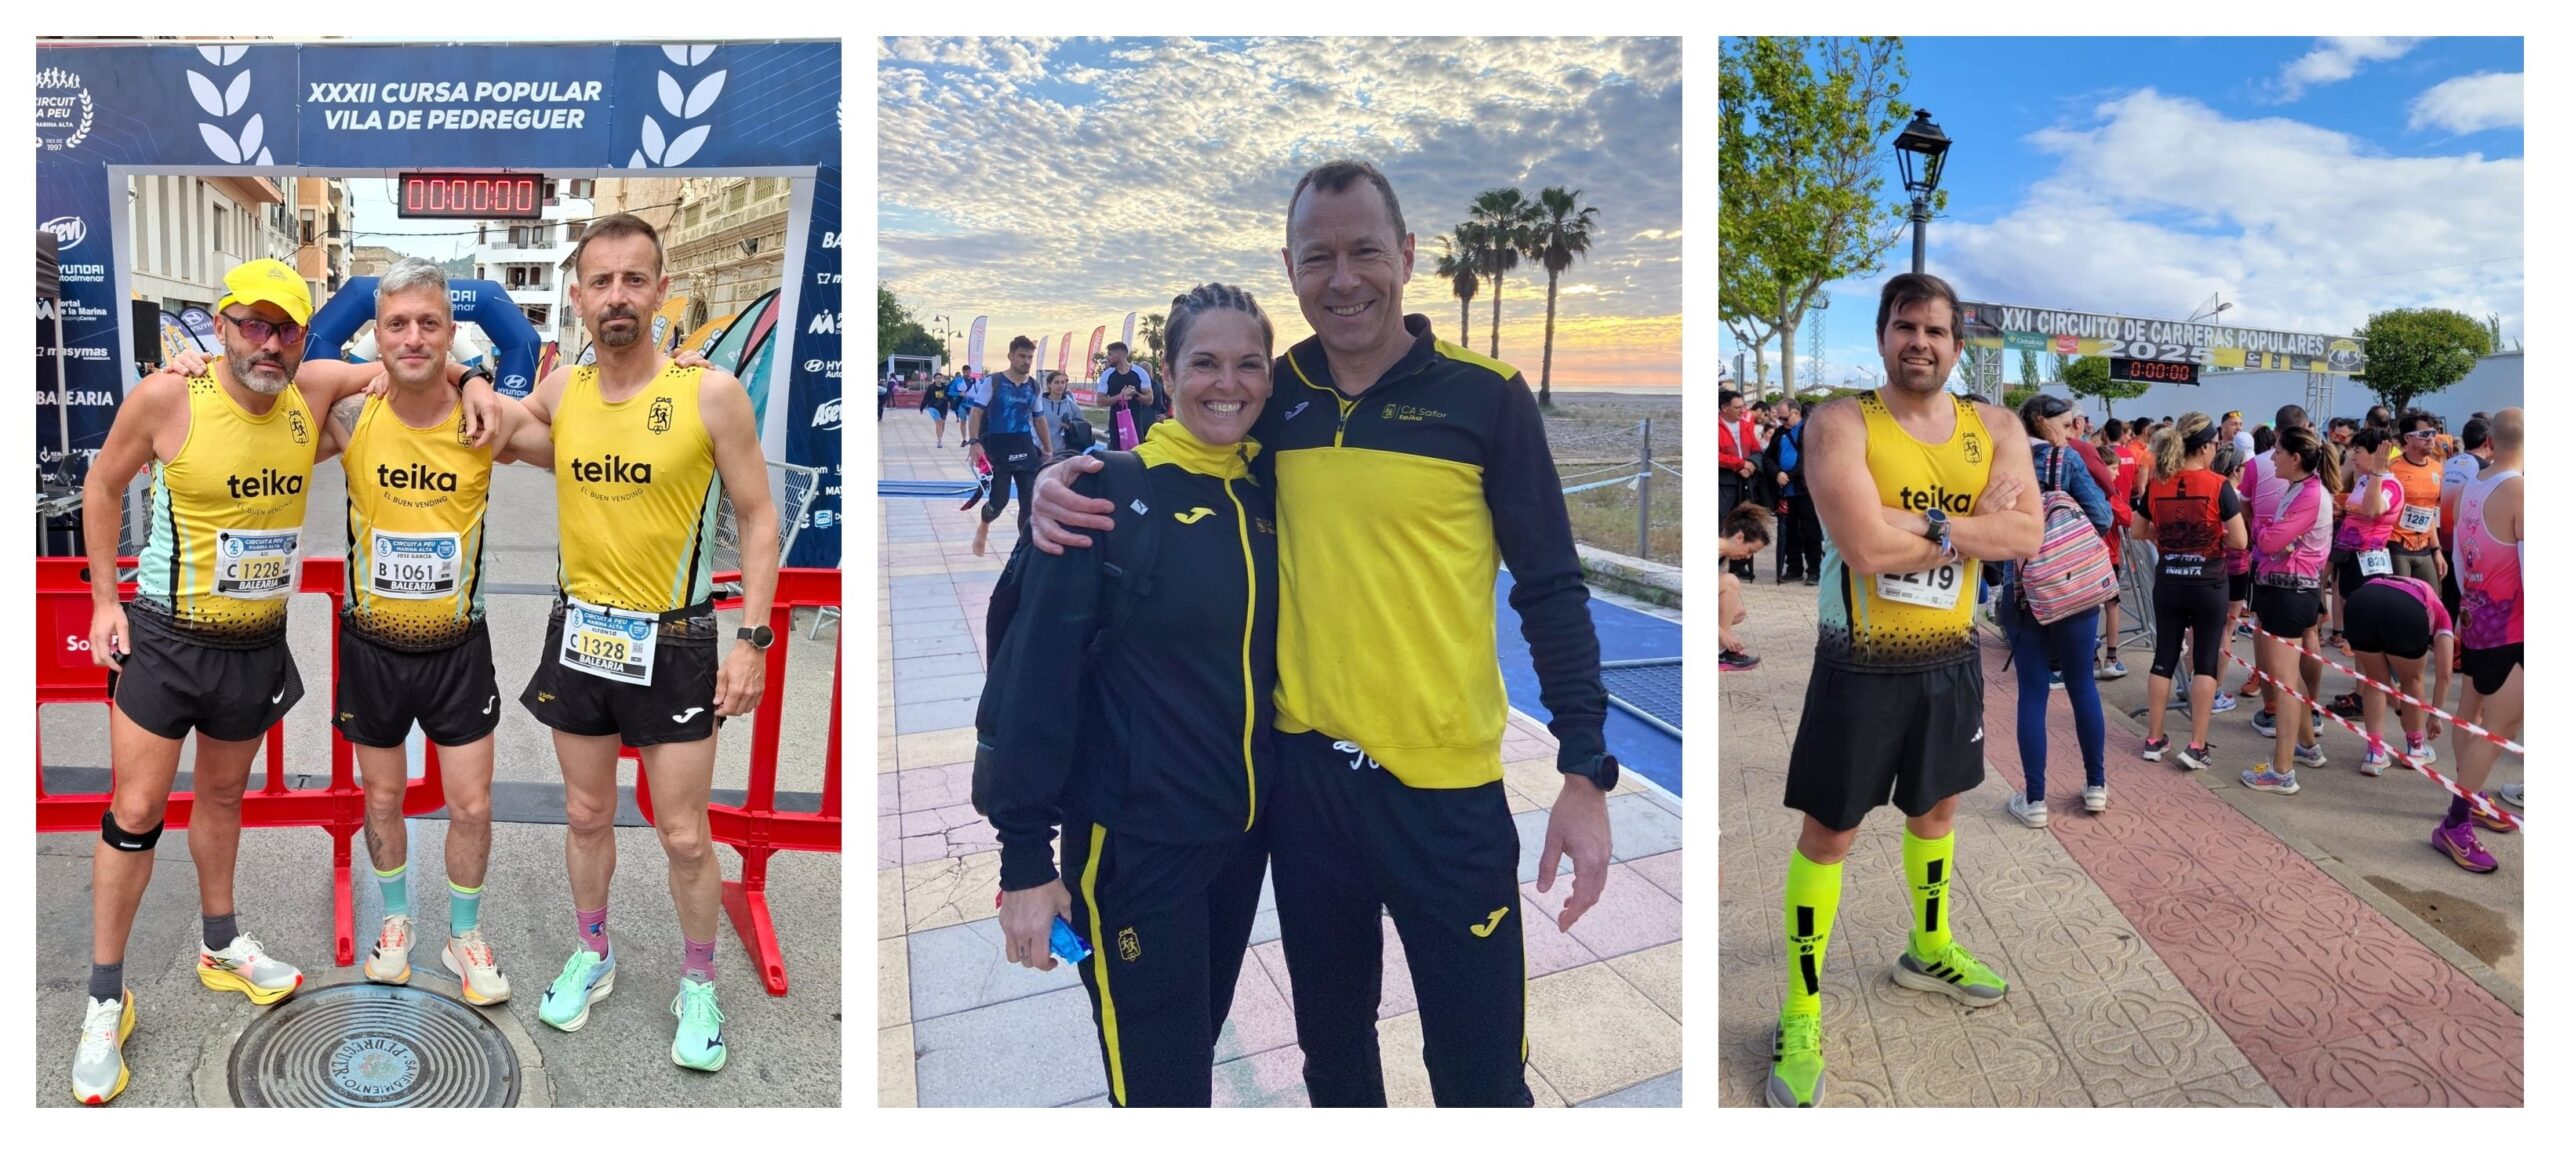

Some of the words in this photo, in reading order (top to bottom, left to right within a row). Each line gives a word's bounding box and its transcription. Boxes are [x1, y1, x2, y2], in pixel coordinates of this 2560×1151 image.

[308, 83, 376, 103] XXXII
[381, 82, 470, 103] CURSA
[474, 81, 602, 102] POPULAR
[47, 109, 71, 118] PEU
[324, 110, 382, 130] VILA
[387, 110, 422, 130] DE
[427, 109, 585, 129] PEDREGUER
[79, 308, 107, 316] Marina
[2000, 307, 2032, 332] XXI
[2037, 311, 2120, 340] CIRCUITO
[2125, 320, 2146, 341] DE
[2151, 321, 2234, 349] CARRERAS
[2239, 330, 2324, 356] POPULARES
[2097, 339, 2215, 363] 2025
[2131, 361, 2190, 381] 0:00:00
[1417, 407, 1447, 418] Safor
[377, 463, 457, 492] teika
[571, 454, 652, 484] teika
[227, 468, 303, 499] teika
[383, 491, 391, 500] EL
[392, 496, 413, 508] BUEN
[414, 496, 448, 508] VENDING
[580, 487, 588, 495] EL
[590, 491, 609, 501] BUEN
[611, 488, 644, 502] VENDING
[1900, 484, 1972, 513] teika
[236, 503, 245, 512] EL
[267, 500, 293, 515] VENDING
[2407, 513, 2430, 526] 1287
[227, 564, 237, 578] C
[244, 562, 280, 579] 1228
[379, 563, 387, 577] B
[394, 564, 433, 580] 1061
[239, 579, 278, 590] BALEARIA
[391, 581, 436, 591] BALEARIA
[570, 634, 578, 648] C
[583, 636, 625, 660] 1328
[579, 654, 624, 672] BALEARIA
